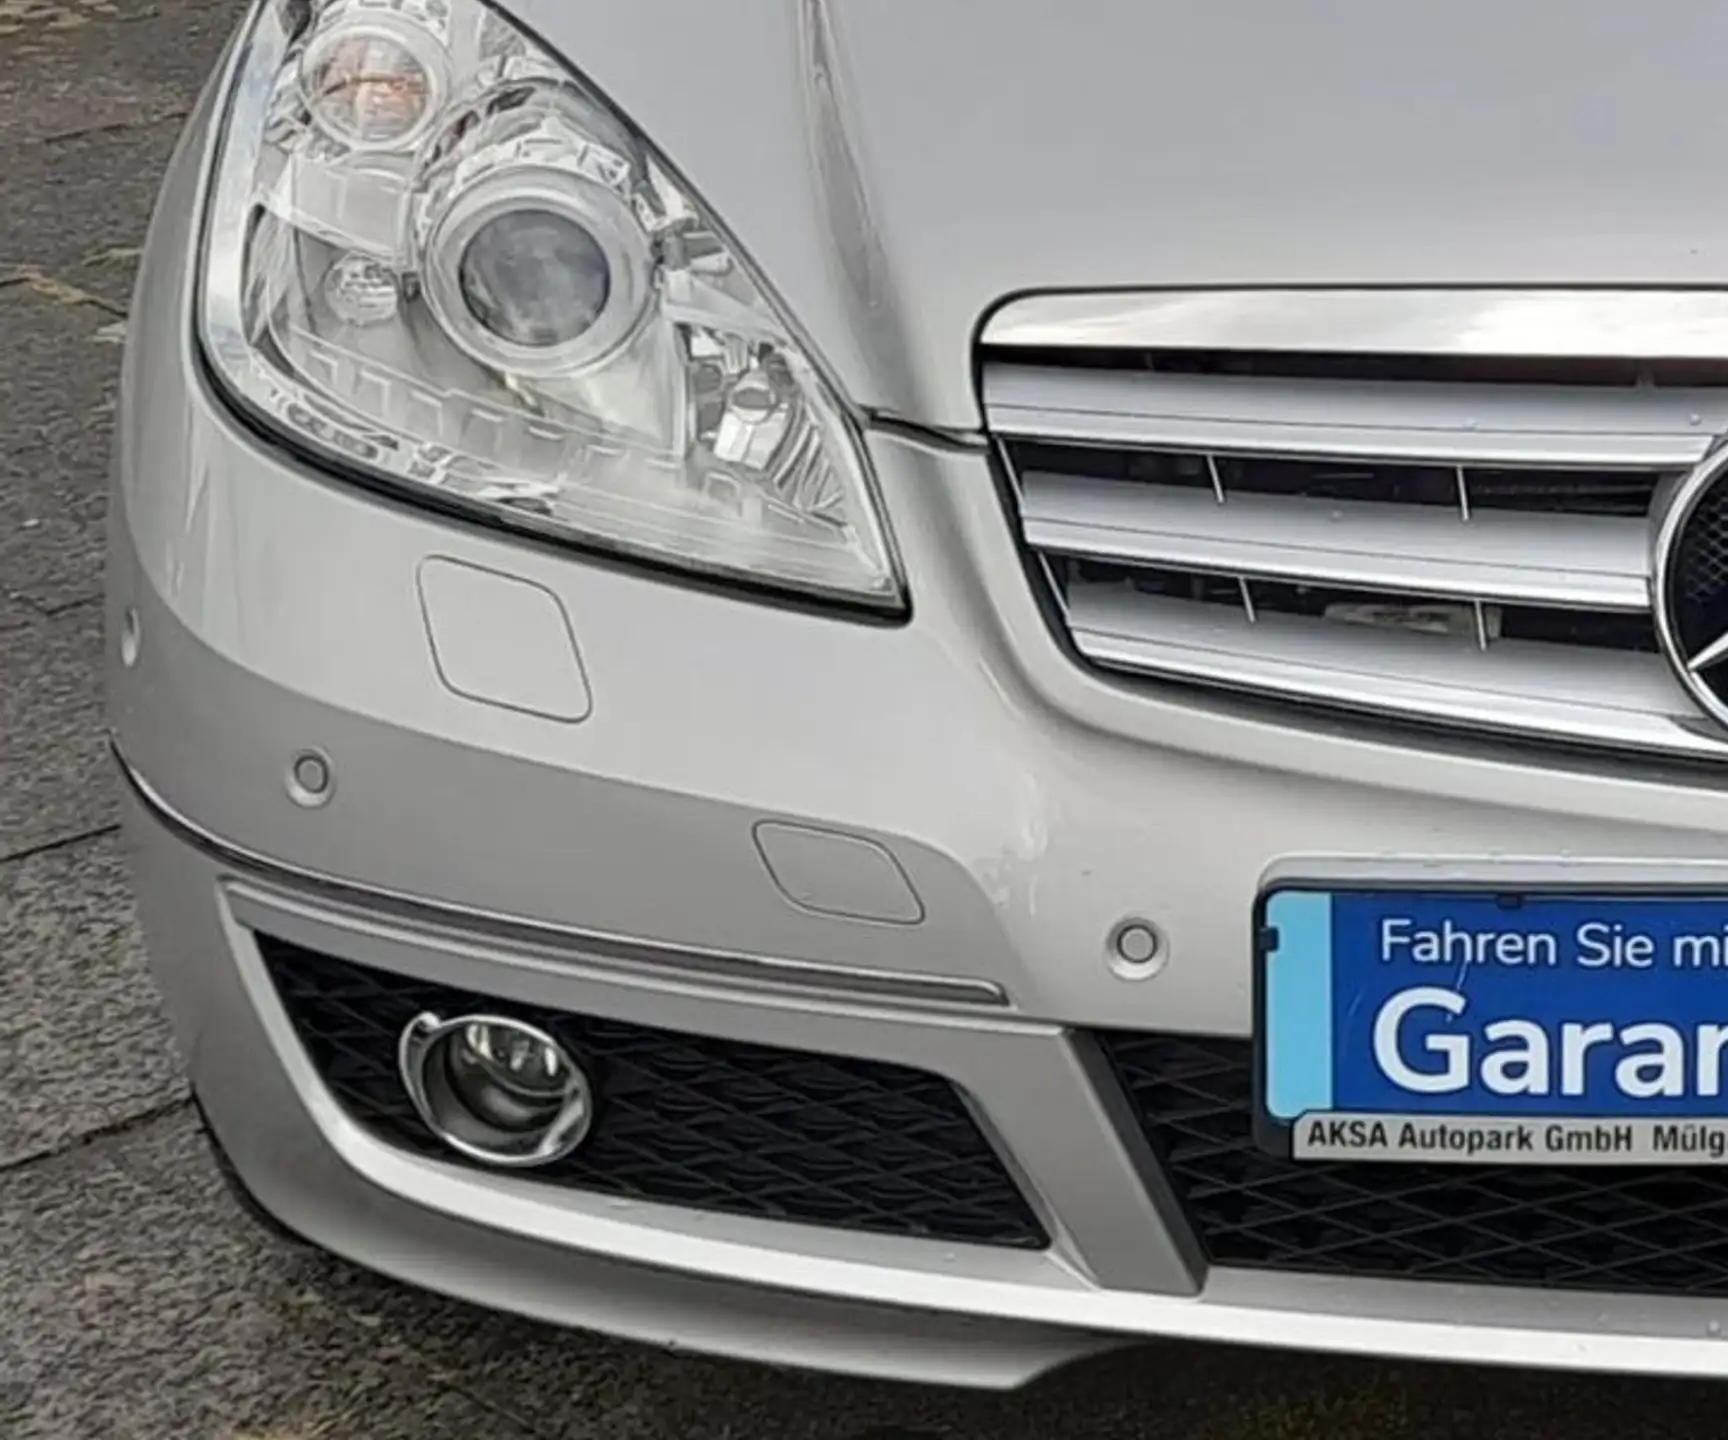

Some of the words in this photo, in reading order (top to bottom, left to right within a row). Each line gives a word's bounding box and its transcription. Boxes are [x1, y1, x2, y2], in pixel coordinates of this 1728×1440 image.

[1381, 918, 1557, 965] Fahren
[1576, 922, 1653, 967] Sie
[1307, 1120, 1389, 1148] AKSA
[1399, 1122, 1534, 1155] Autopark
[1545, 1124, 1633, 1152] GmbH
